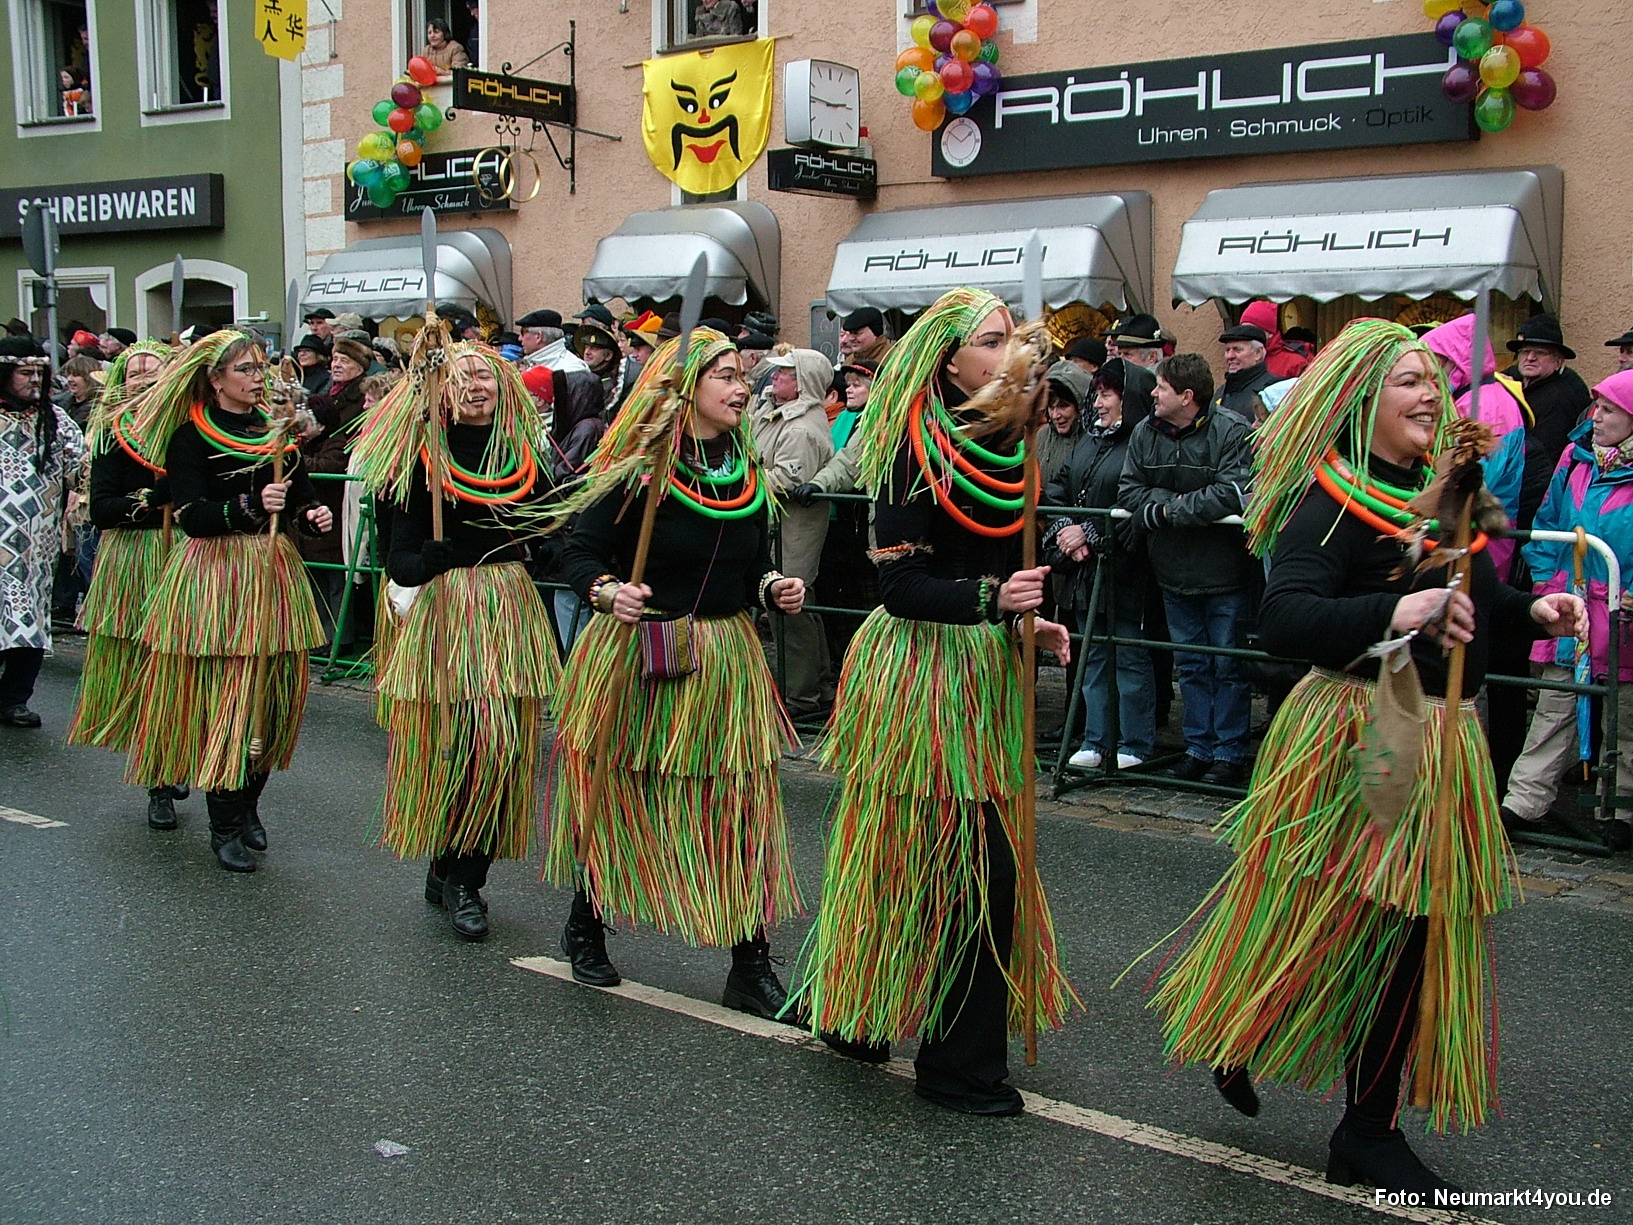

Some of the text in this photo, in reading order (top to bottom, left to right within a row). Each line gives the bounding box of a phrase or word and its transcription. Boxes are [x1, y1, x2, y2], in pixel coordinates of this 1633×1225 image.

[285, 13, 304, 42] 华
[467, 78, 562, 106] RÖHLICH
[995, 46, 1457, 129] RÖHLICH
[1138, 105, 1434, 145] Uhren Schmuck Optik
[794, 153, 874, 175] RÖHLICH
[18, 187, 196, 225] SHREIBWAREN
[1217, 226, 1452, 255] RÖHLICH
[307, 277, 423, 296] RÖHLICH
